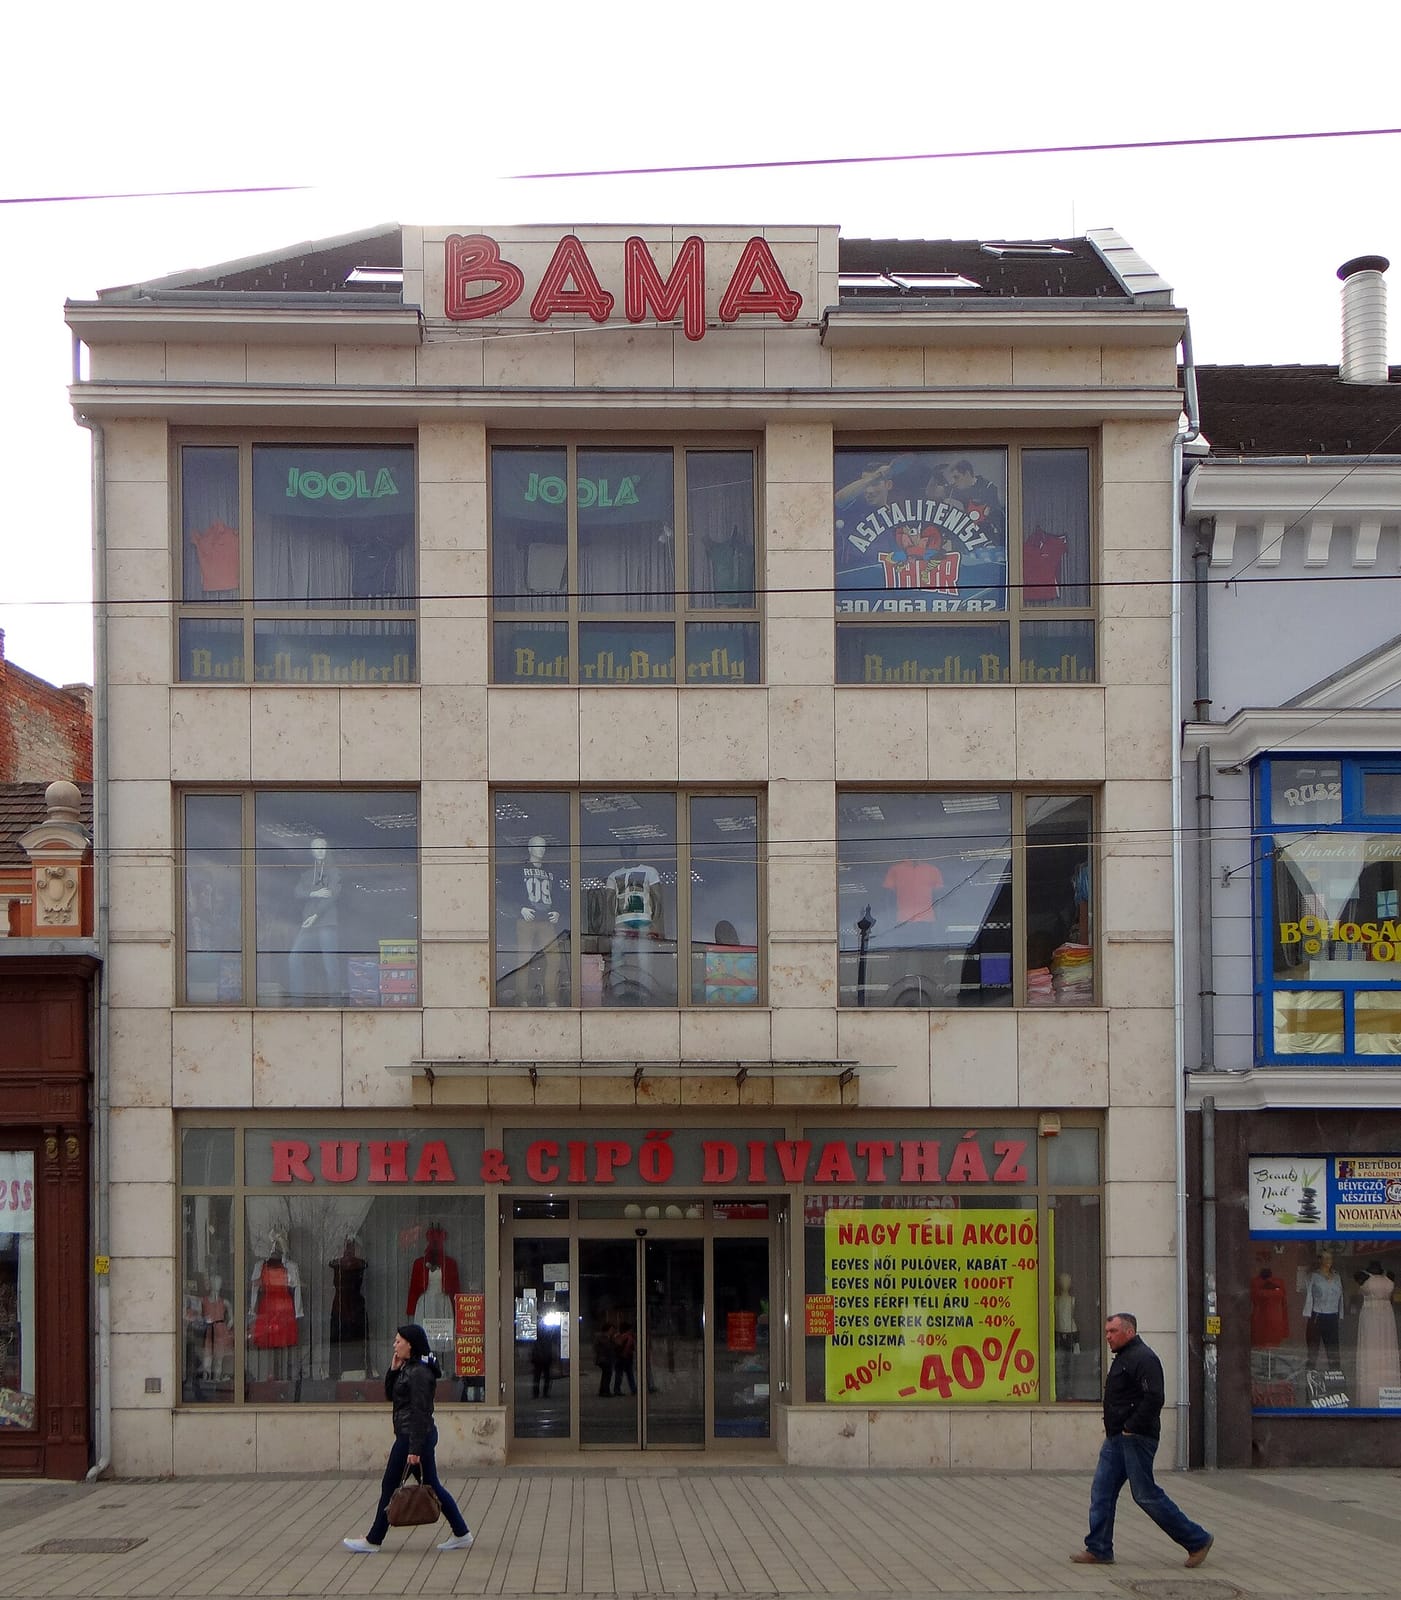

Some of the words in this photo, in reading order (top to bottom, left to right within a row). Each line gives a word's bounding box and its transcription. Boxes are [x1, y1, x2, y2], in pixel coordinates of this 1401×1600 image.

[445, 234, 803, 341] BAMA
[286, 467, 399, 500] JOOLA
[524, 472, 640, 508] JOOLA
[848, 499, 989, 553] ASZTALITENISZ
[271, 1139, 457, 1184] RUHA
[480, 1147, 512, 1184] &
[526, 1130, 675, 1184] CIPŐ
[702, 1129, 1029, 1183] DIVATHÁZ
[838, 1222, 901, 1246] NAGY
[908, 1217, 954, 1246] TÉLI
[831, 1258, 869, 1271] EGYES
[874, 1255, 897, 1271] NŐI
[966, 1255, 1008, 1271] KABÁT
[1011, 1258, 1039, 1271] -40
[831, 1277, 869, 1290] EGYES
[874, 1274, 897, 1290] NŐI
[901, 1274, 958, 1290] PULÓVER
[963, 1276, 1014, 1290] 1000FT
[874, 1293, 909, 1309] FÉRFI
[913, 1294, 939, 1309] TÉLI
[943, 1293, 969, 1309] ÁRU
[973, 1297, 1011, 1310] -40%
[873, 1315, 922, 1328] GYEREK
[926, 1315, 973, 1328] CSIZMA
[978, 1315, 1016, 1329] -40%
[831, 1331, 854, 1347] NŐI
[858, 1334, 906, 1347] CSIZMA
[910, 1334, 948, 1347] -40%
[838, 1353, 892, 1395] -40%
[898, 1328, 1035, 1399] -40%
